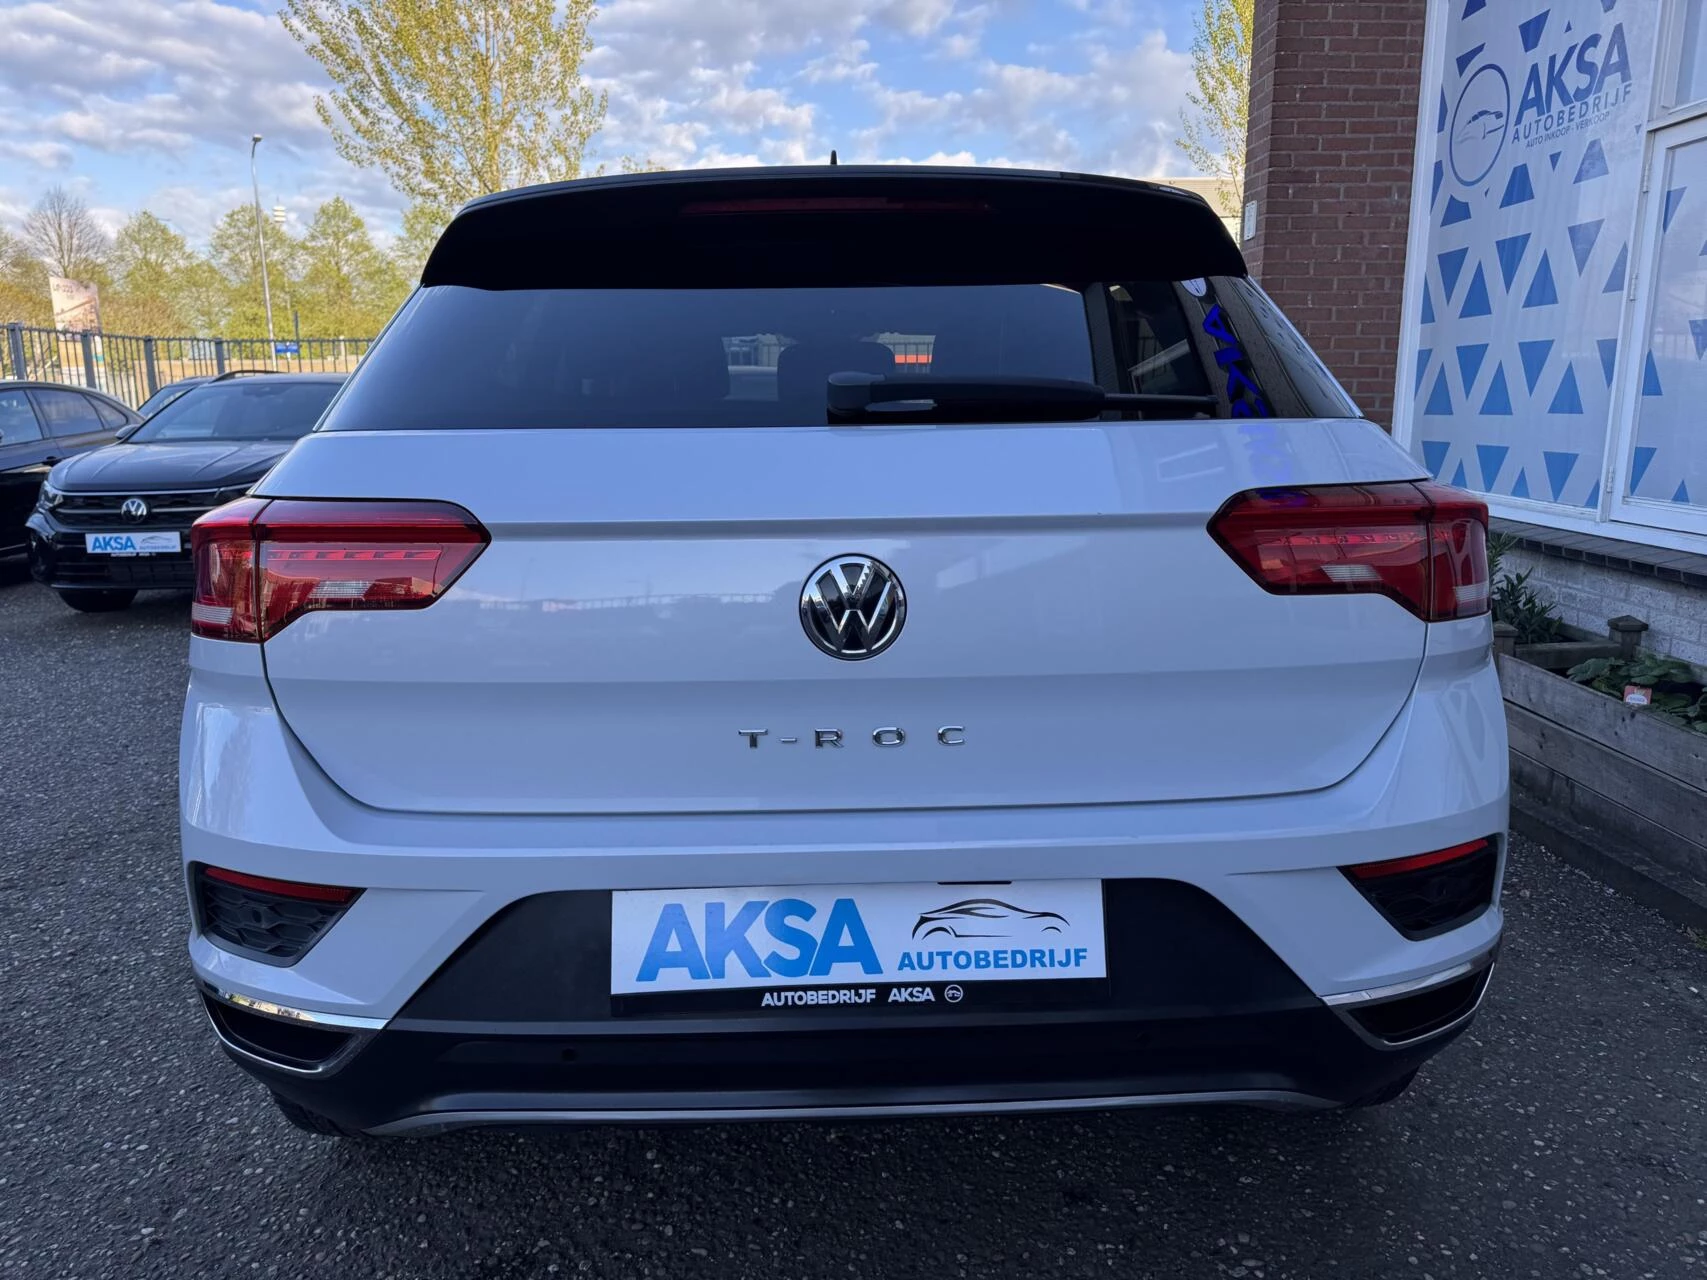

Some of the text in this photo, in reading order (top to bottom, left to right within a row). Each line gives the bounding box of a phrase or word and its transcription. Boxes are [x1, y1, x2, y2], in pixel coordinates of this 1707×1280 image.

[1514, 22, 1633, 126] AKSA
[1511, 83, 1633, 144] AUTOBEDRIJF
[1575, 111, 1610, 131] VERKOOP
[91, 535, 137, 551] AKSA
[738, 725, 966, 749] T-ROC
[635, 898, 884, 983] AKSA
[897, 948, 1088, 972] AUTOBEDRIJF
[761, 987, 936, 1007] AUTOBEDRIJF AKSA
